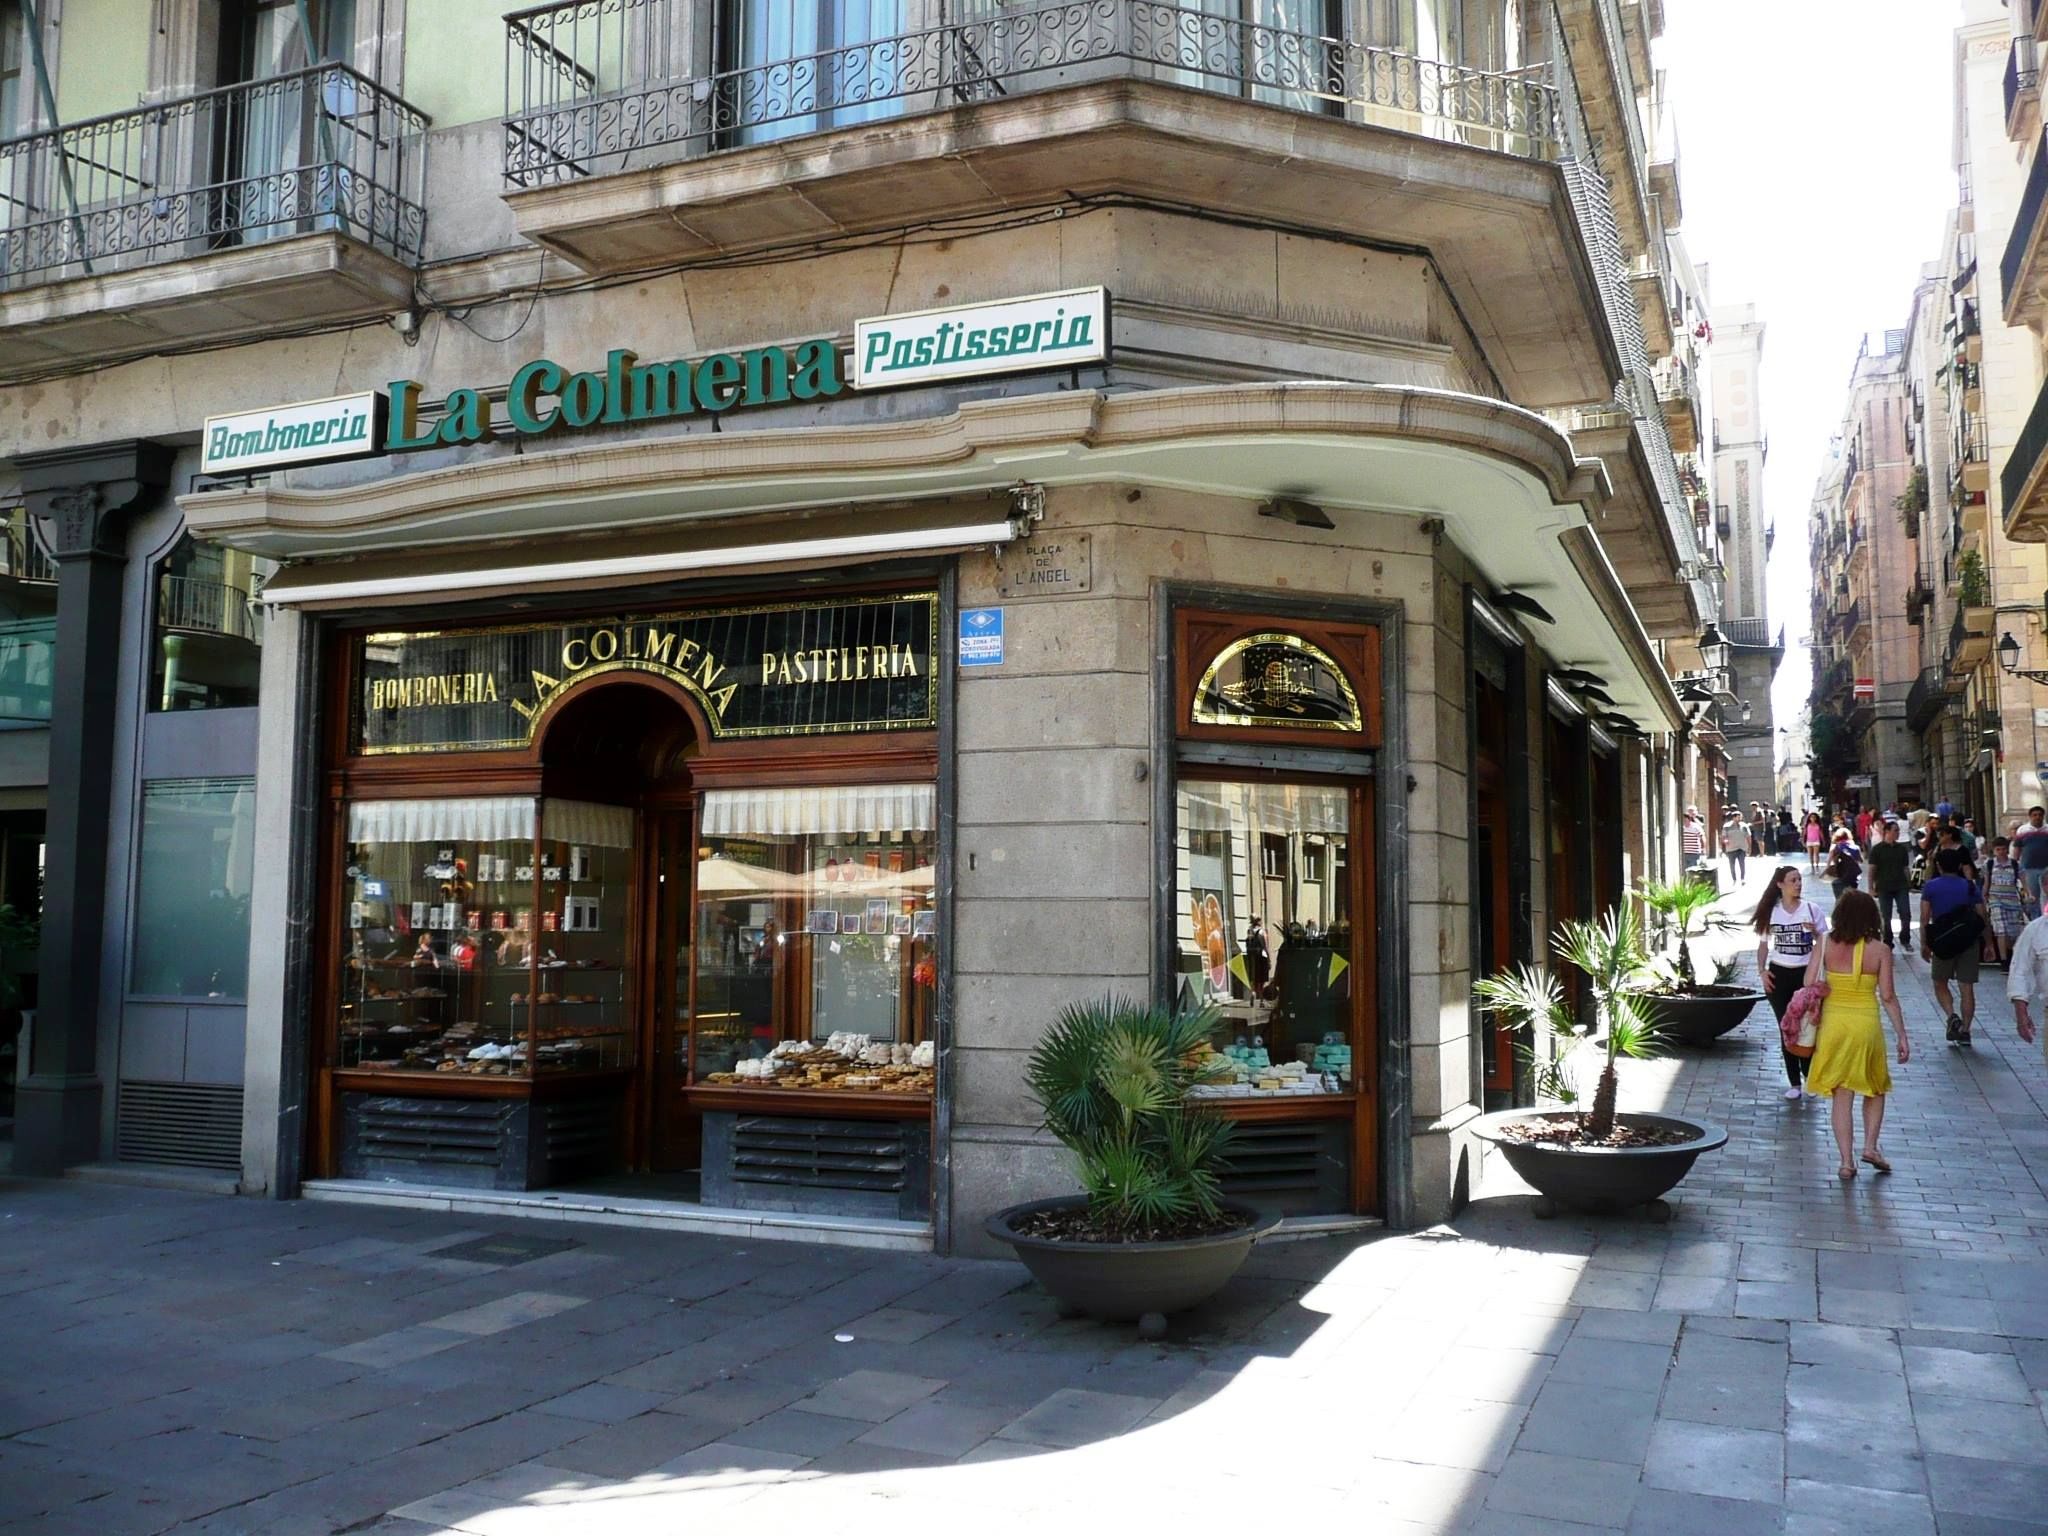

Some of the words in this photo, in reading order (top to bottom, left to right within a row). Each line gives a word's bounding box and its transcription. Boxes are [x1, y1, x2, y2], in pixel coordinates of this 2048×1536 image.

[864, 308, 1094, 373] Pastisseria
[384, 379, 487, 451] La
[506, 338, 848, 434] Colmena
[207, 409, 367, 461] Bomboneria
[1026, 545, 1062, 557] PLAÇA
[1036, 558, 1050, 567] DE
[510, 670, 561, 720] LA
[561, 626, 738, 718] COLMENA
[761, 643, 919, 686] PASTELERIA
[372, 671, 500, 710] BOMBONERIA
